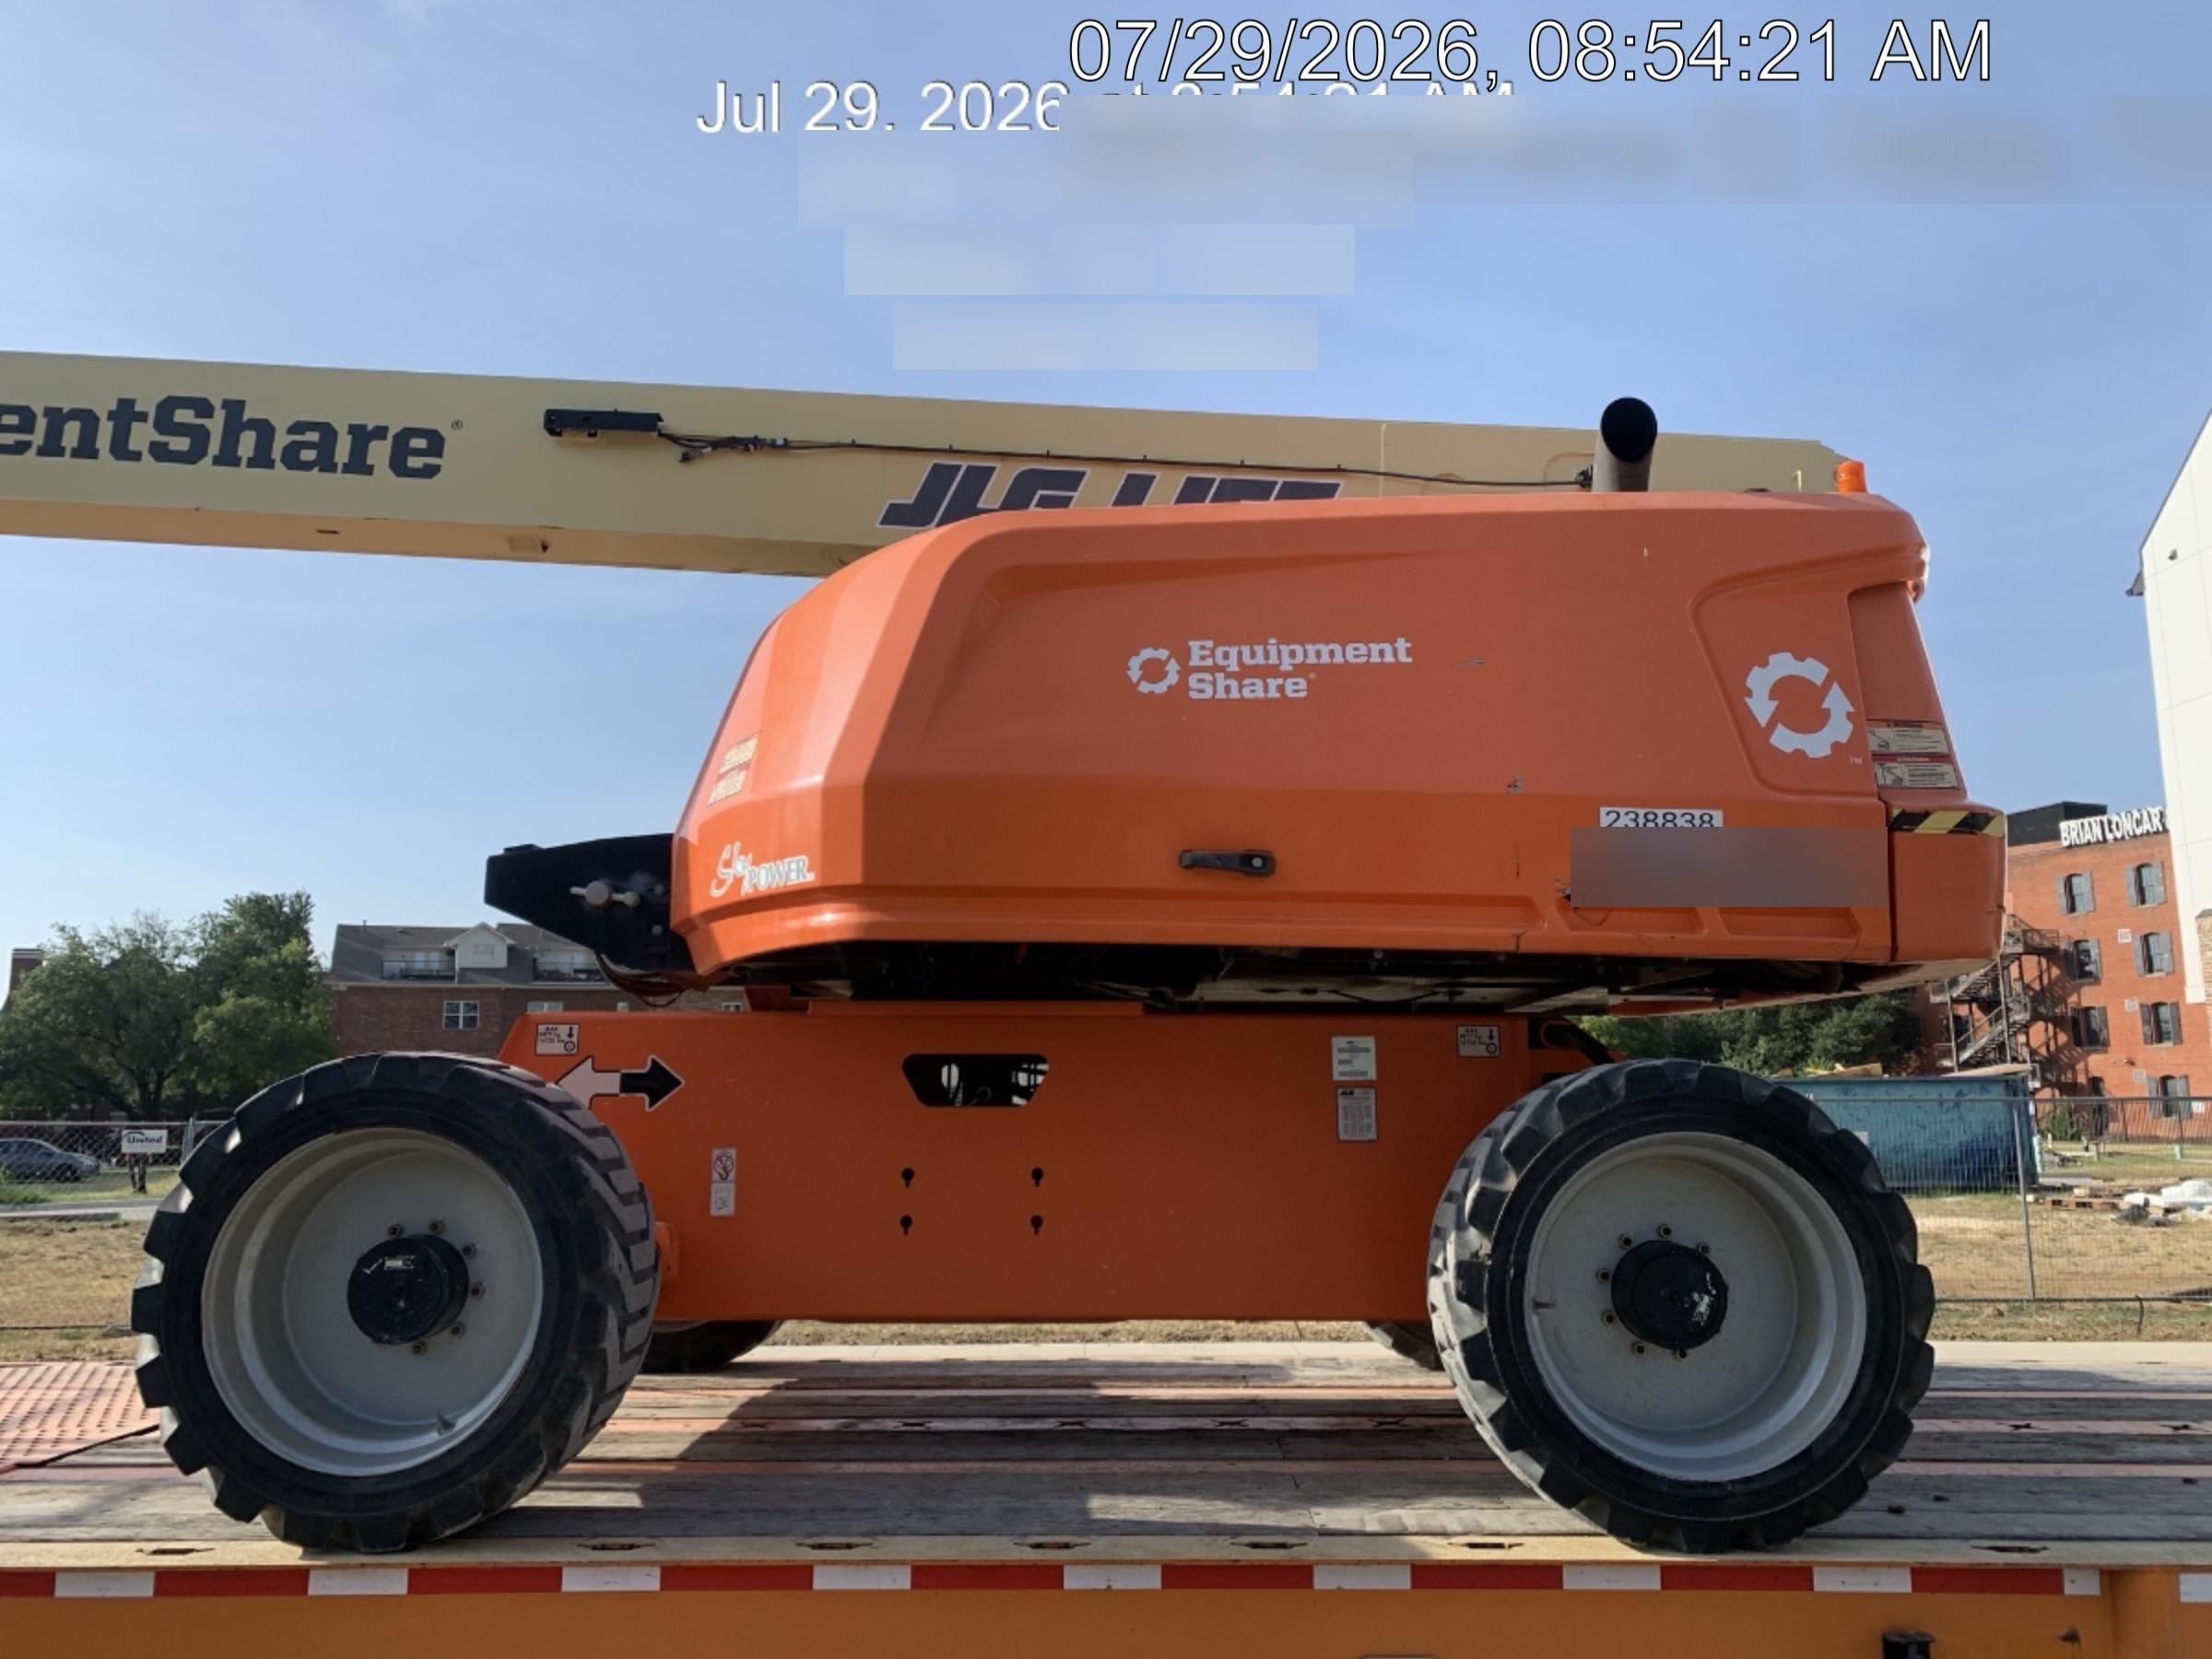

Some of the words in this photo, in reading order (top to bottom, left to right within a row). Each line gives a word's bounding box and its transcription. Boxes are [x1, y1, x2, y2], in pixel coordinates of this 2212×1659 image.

[1188, 639, 1413, 671] Equipment
[1188, 674, 1307, 700] Share
[2059, 818, 2104, 847] BRIAN
[2104, 806, 2163, 840] LONCAR
